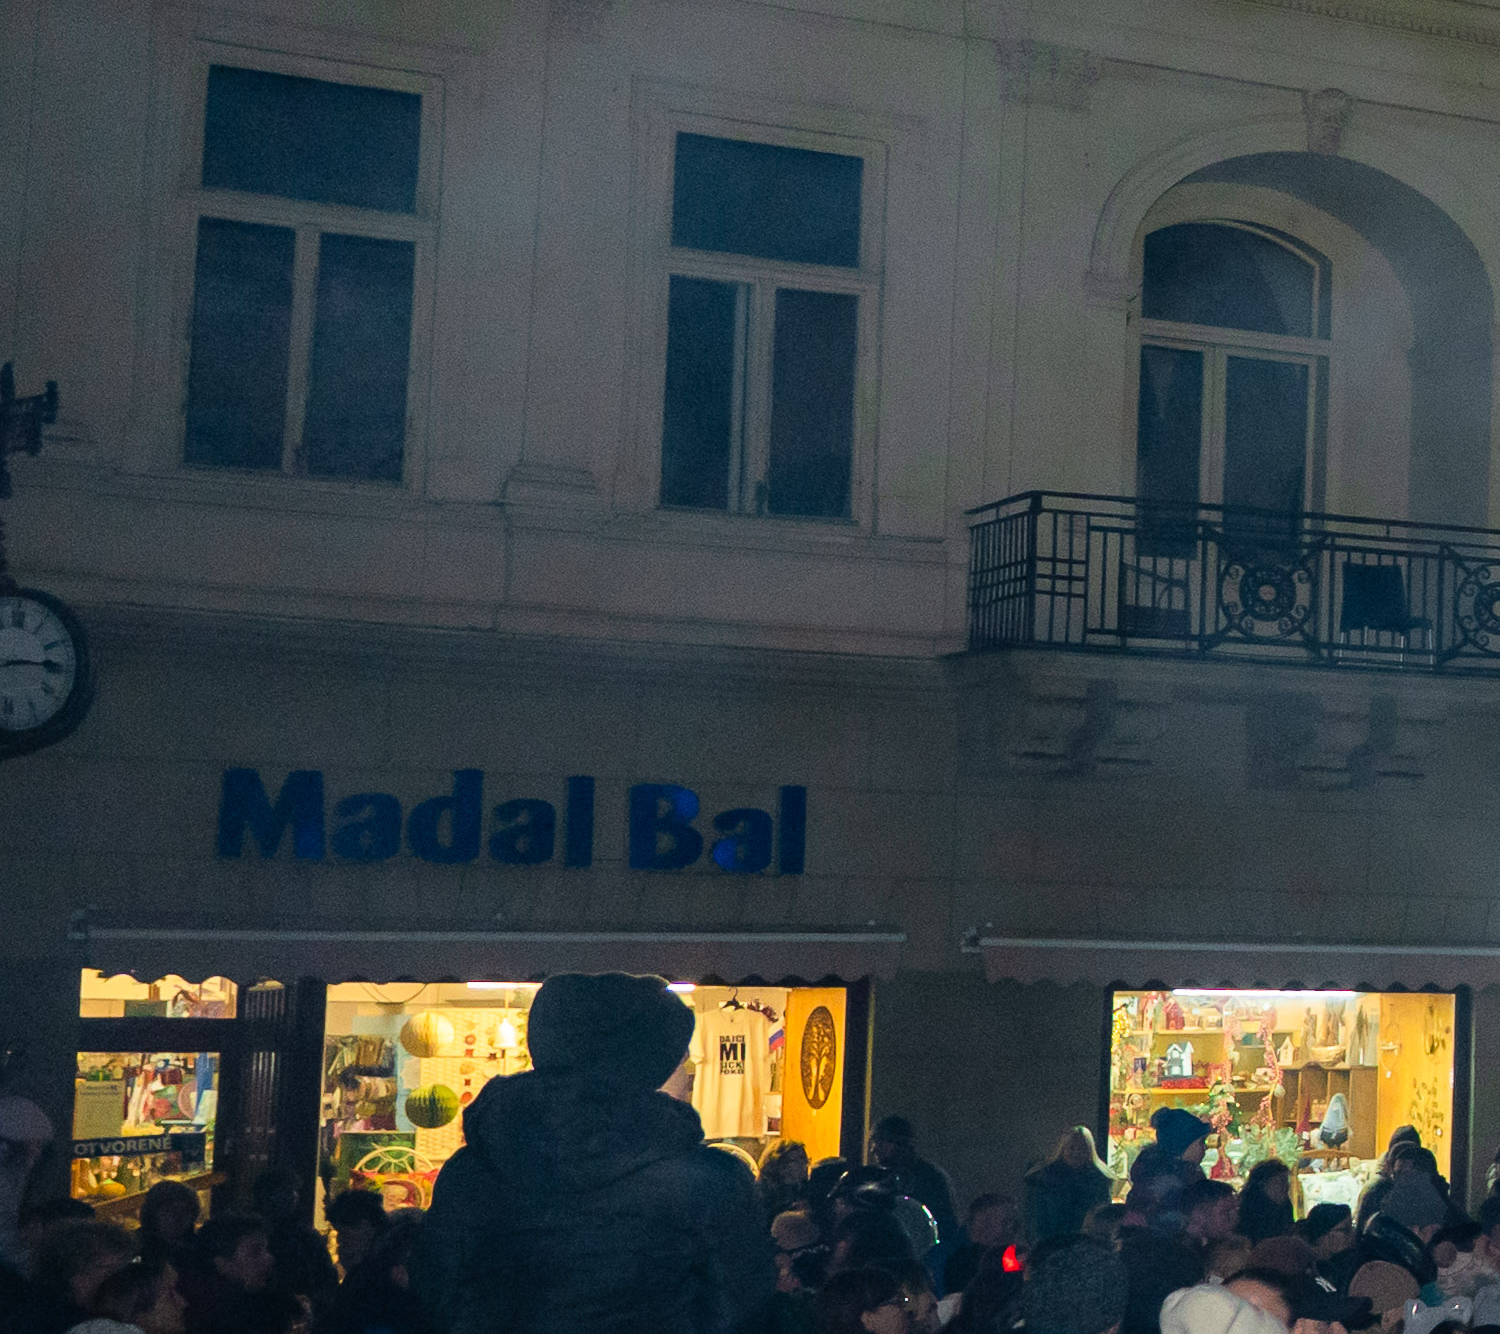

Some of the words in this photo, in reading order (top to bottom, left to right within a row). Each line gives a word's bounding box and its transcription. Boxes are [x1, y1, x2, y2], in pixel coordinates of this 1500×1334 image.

[217, 767, 596, 868] Madal
[628, 782, 807, 875] Bal
[719, 1043, 746, 1061] MI
